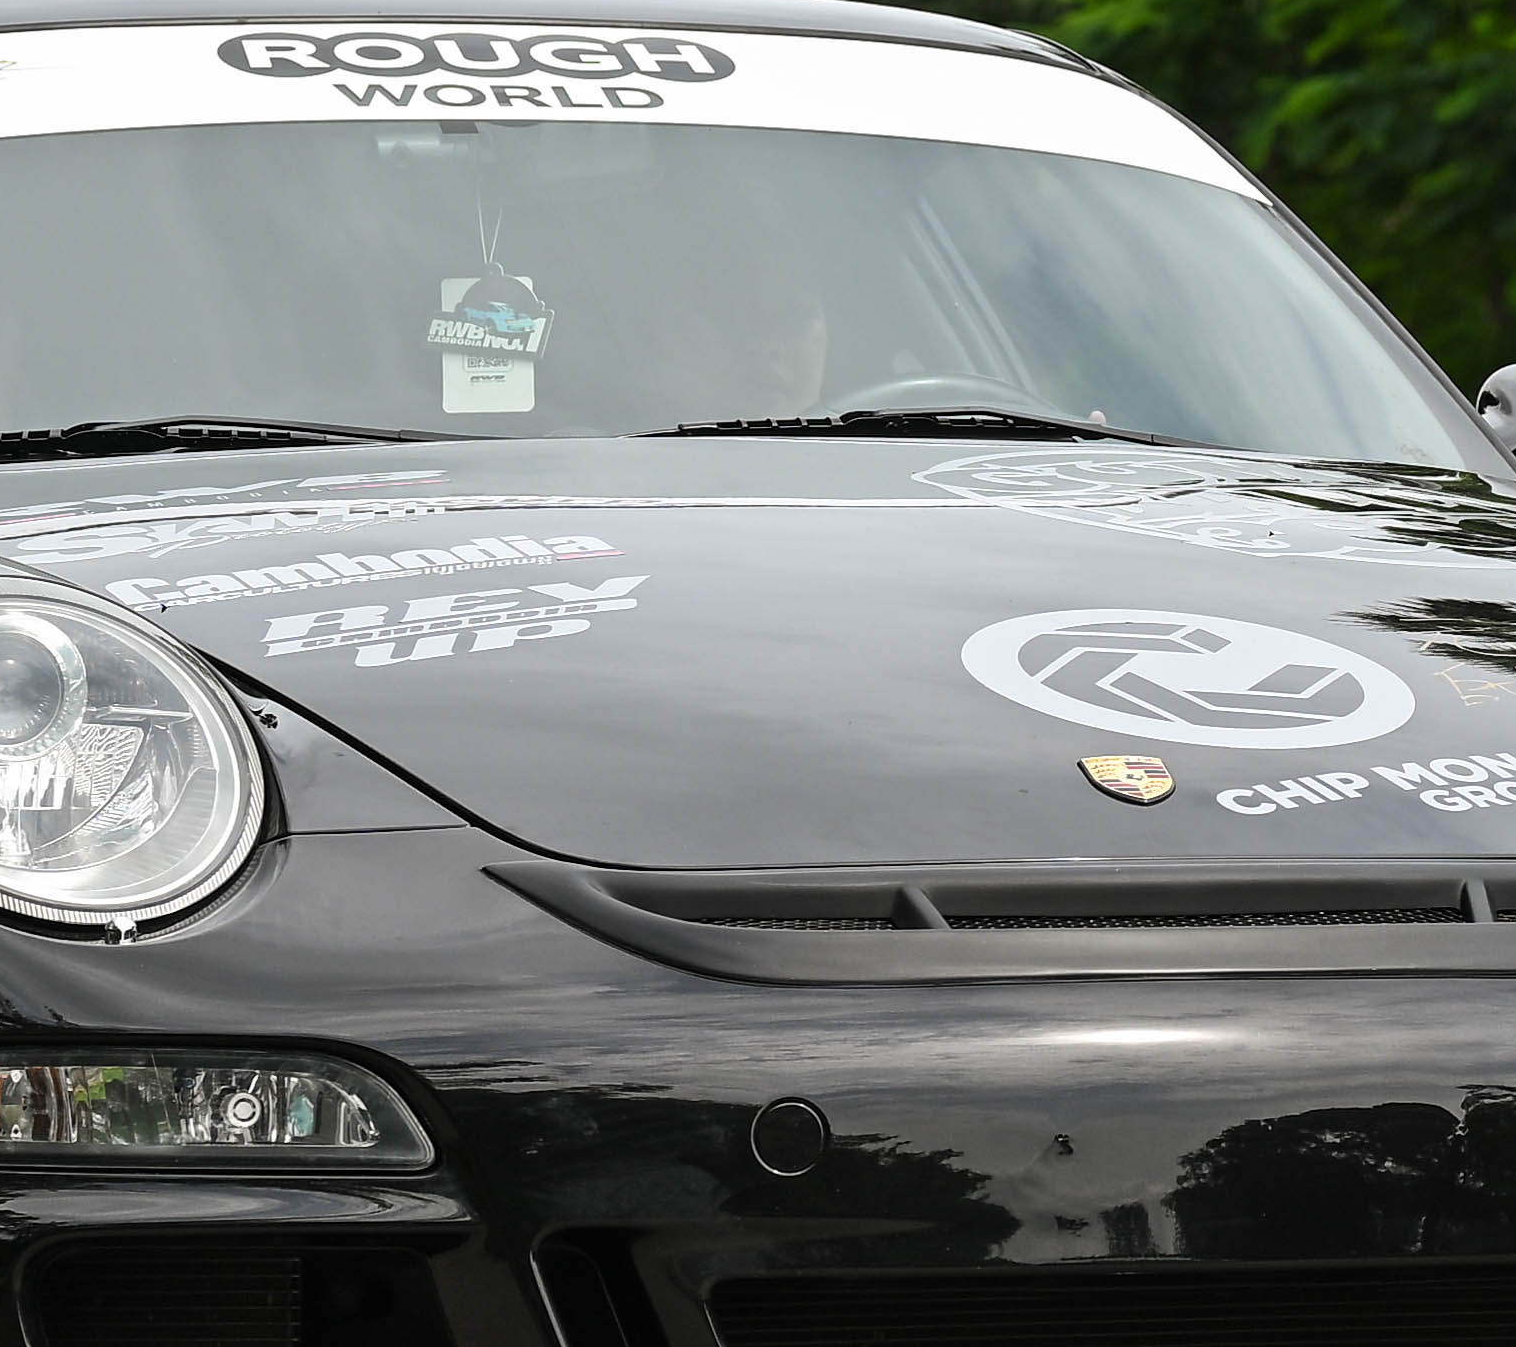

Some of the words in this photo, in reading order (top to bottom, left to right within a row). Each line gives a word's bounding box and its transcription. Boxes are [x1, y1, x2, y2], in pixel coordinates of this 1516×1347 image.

[240, 38, 720, 74] ROUGH
[333, 83, 665, 109] WORLD
[426, 334, 483, 348] CAMBODIA
[428, 318, 485, 340] RWB
[82, 485, 323, 516] CAMBODIA
[105, 535, 618, 606] Cambodia
[260, 574, 651, 642] REV
[1215, 771, 1371, 816] CHIP
